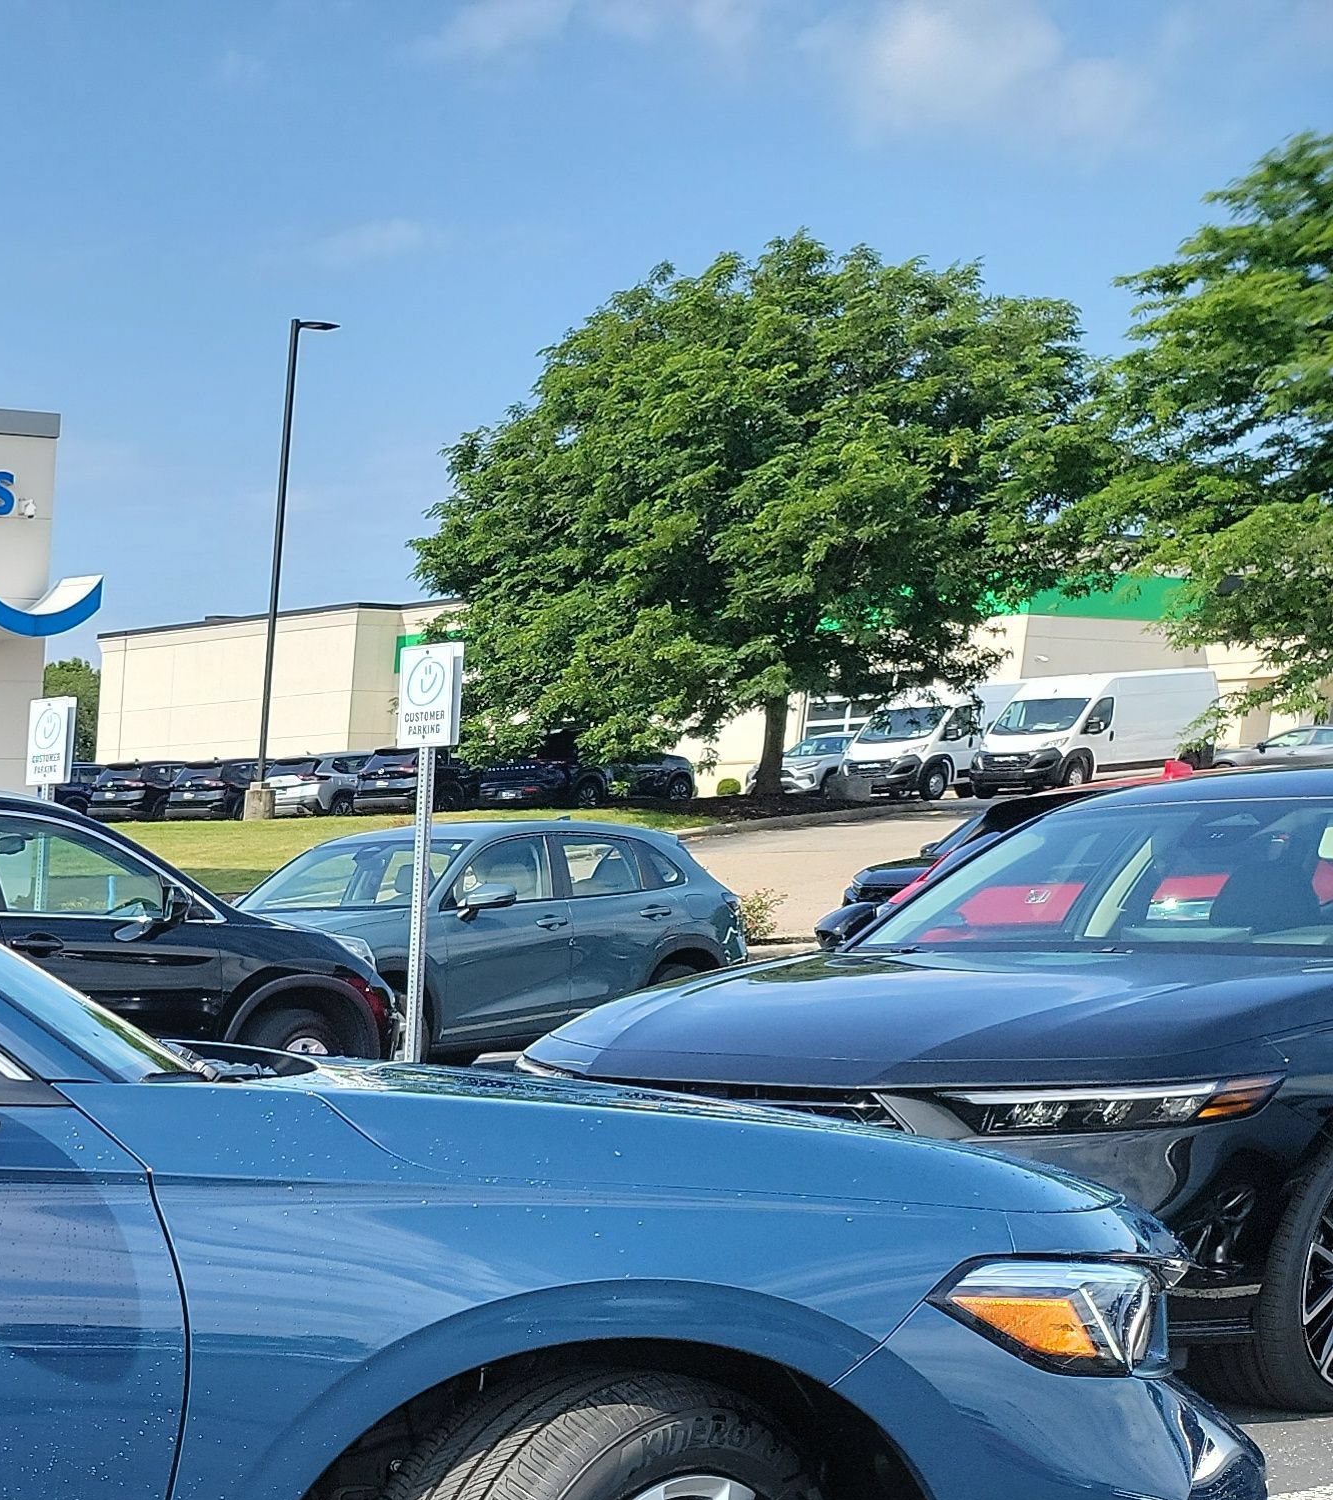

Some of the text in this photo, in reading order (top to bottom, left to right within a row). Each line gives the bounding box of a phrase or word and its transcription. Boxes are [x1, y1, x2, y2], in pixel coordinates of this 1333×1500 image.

[404, 710, 445, 723] CUSTOMER
[408, 723, 441, 735] PARKING
[32, 752, 61, 764] CUSTOMER
